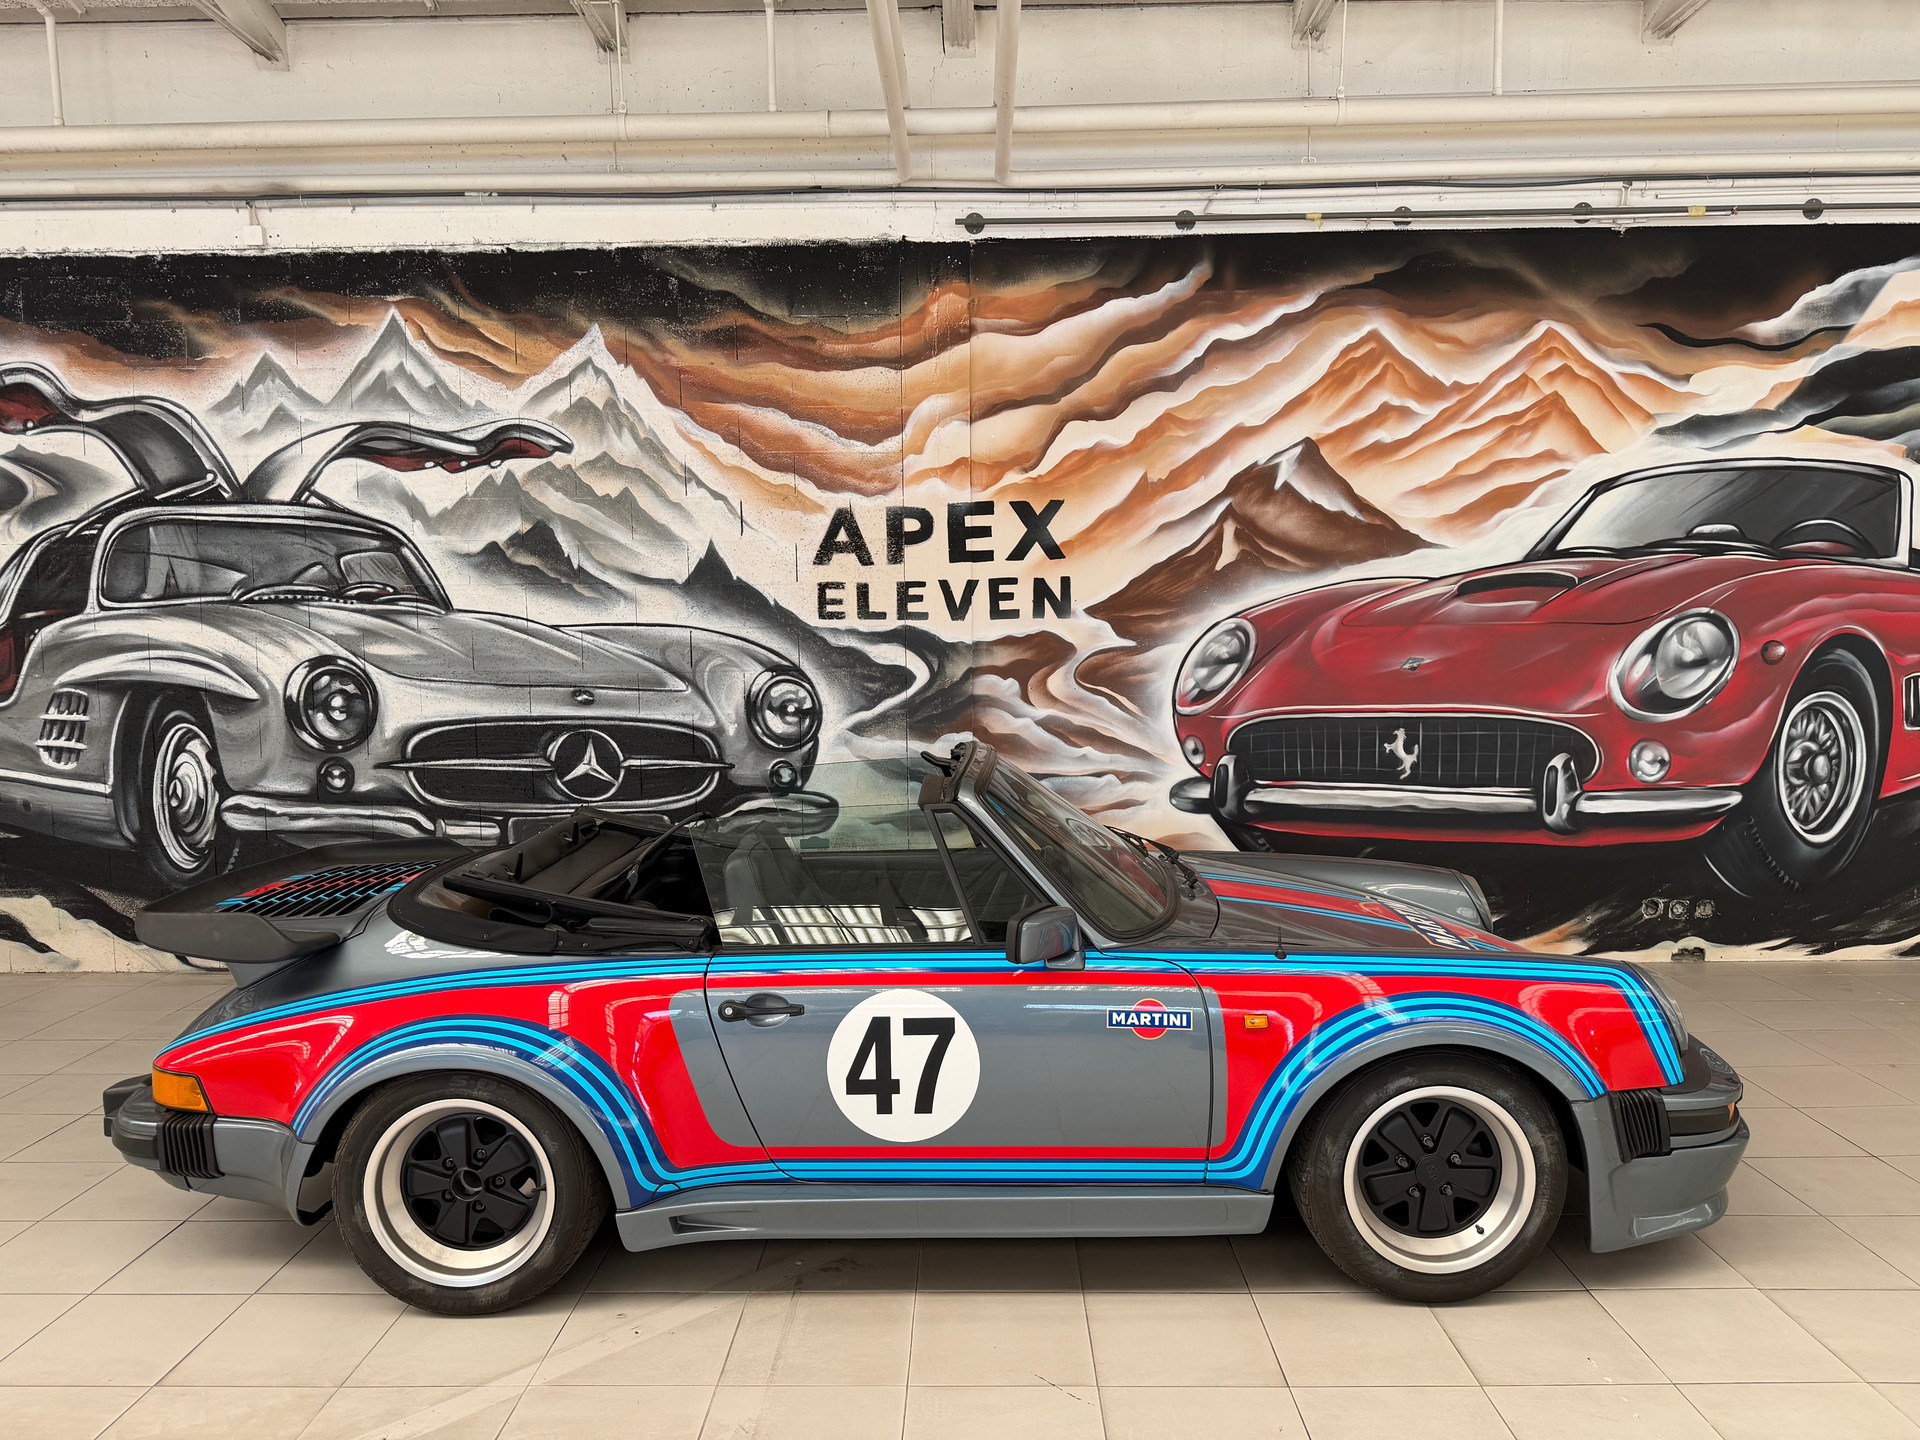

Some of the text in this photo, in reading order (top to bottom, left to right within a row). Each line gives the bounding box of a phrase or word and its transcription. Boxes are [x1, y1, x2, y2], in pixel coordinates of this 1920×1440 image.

[813, 499, 1067, 566] APEX
[816, 576, 1072, 621] ELEVEN
[1112, 1012, 1187, 1027] MARTINI
[846, 1016, 956, 1115] 47
